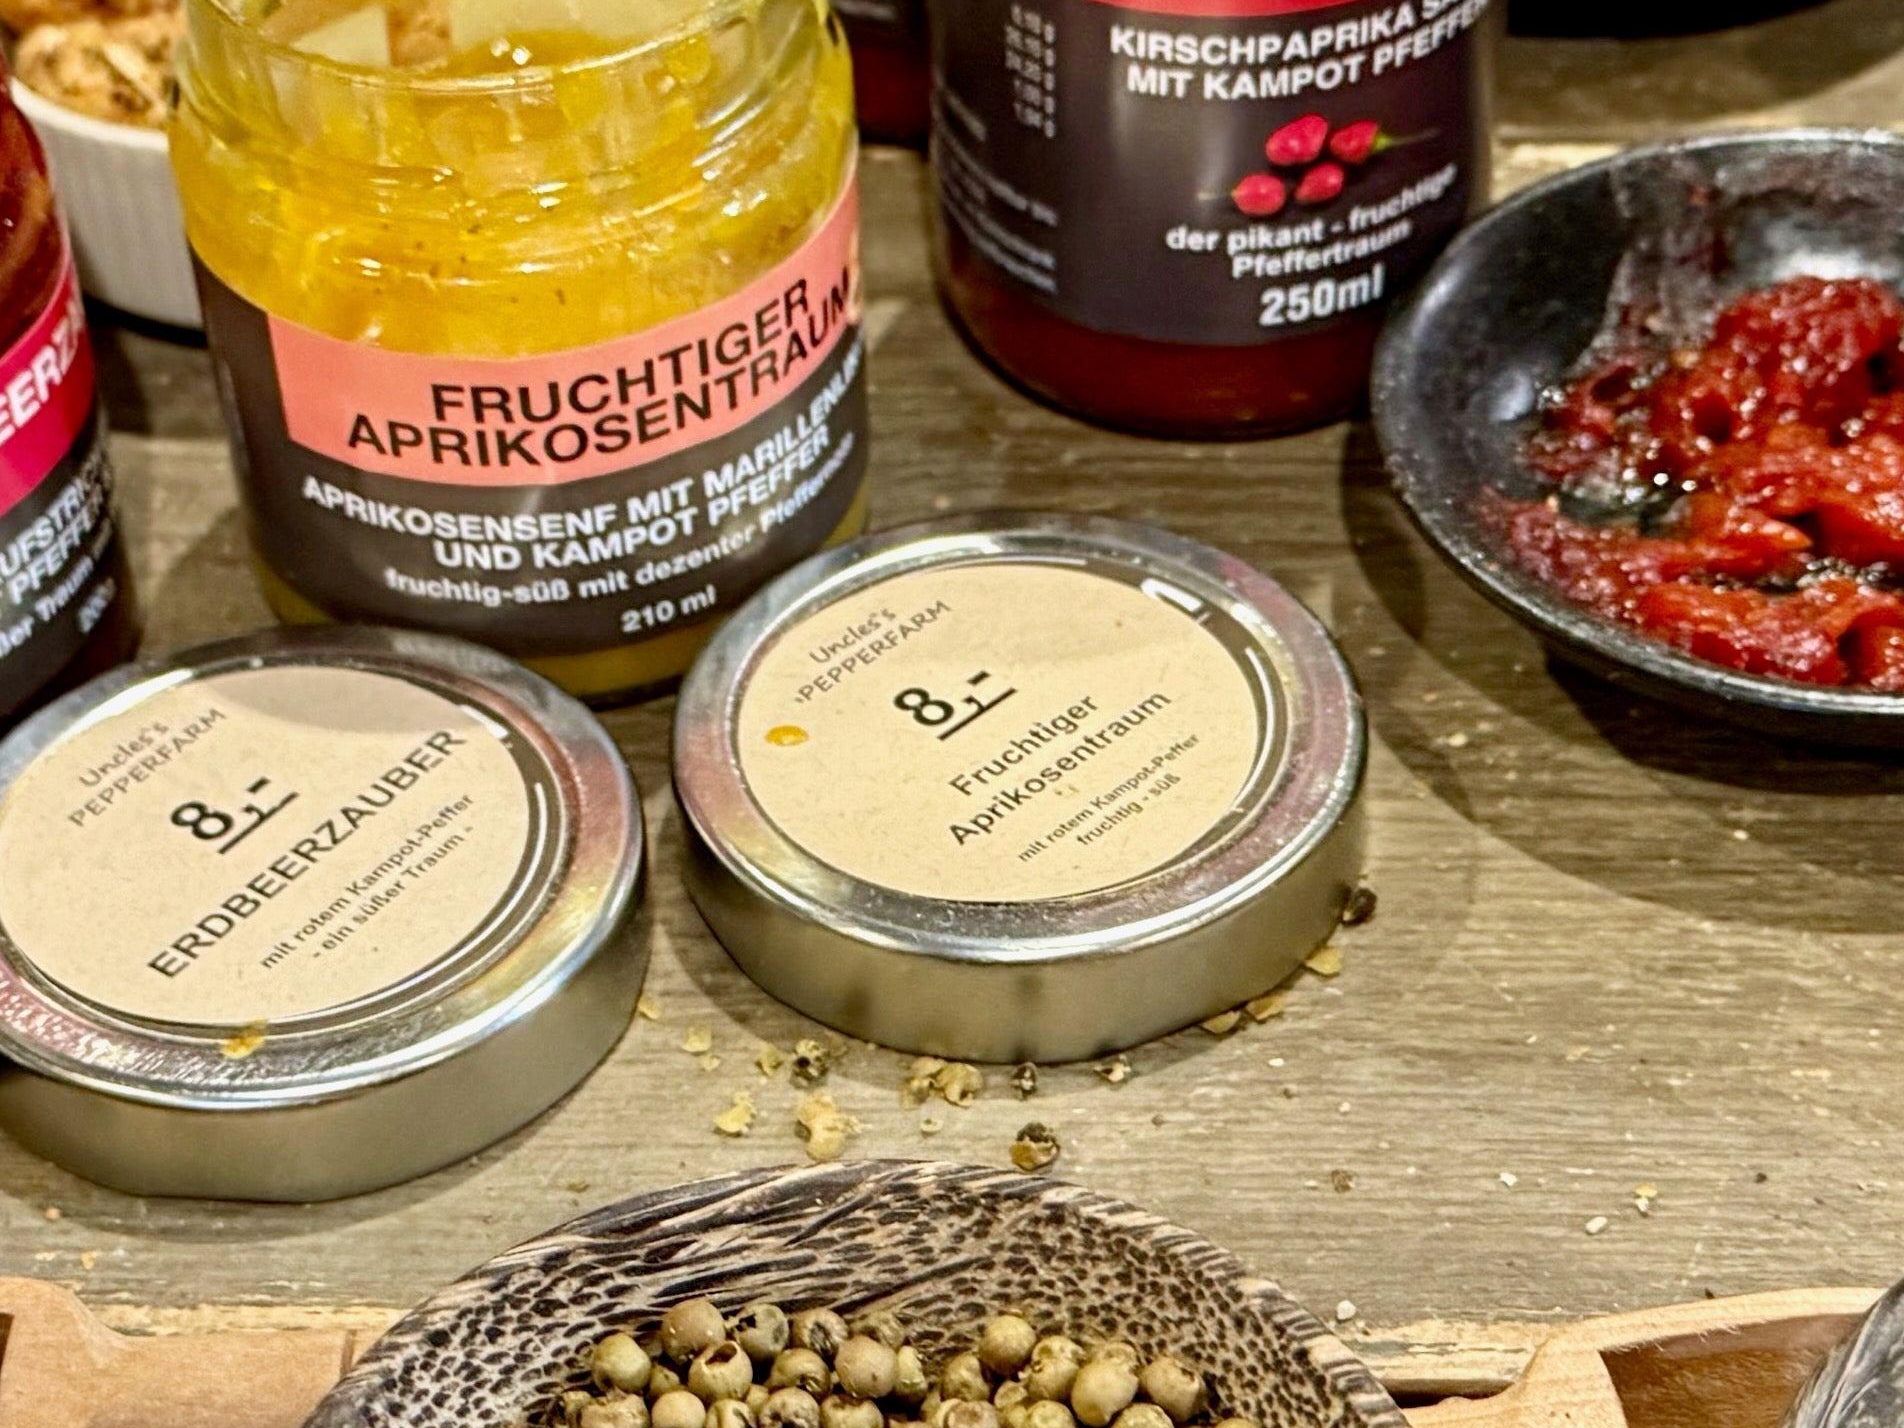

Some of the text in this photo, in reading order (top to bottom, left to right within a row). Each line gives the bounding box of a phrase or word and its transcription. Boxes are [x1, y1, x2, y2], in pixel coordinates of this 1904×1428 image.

[1108, 2, 1415, 69] KIRSCHPAPRIKA
[1126, 66, 1194, 100] MIT
[1202, 54, 1362, 103] KAMPOT
[1165, 163, 1459, 262] der pikant fruchtige
[1231, 220, 1412, 280] Pfeffertraum
[1258, 264, 1385, 327] 250ml
[430, 277, 808, 424] FRUCHTIGER
[302, 475, 616, 543] APRIKOSENSENF
[626, 477, 694, 524] MIT
[435, 538, 521, 572] UND
[531, 505, 699, 570] KAMPOT
[707, 424, 829, 526] PFEFFER
[385, 526, 755, 608] fruchtig-süß mit dezenter
[620, 584, 717, 634] 210 ml
[797, 600, 952, 703] PEPPERFARM
[68, 708, 227, 827] PEPPERFARM
[948, 689, 1172, 849] Aprikosentraum
[950, 691, 1102, 799] Fruchtiger
[1018, 840, 1049, 863] mit
[1046, 808, 1095, 844] rotem
[1076, 773, 1182, 846] fruchtig süß
[147, 728, 468, 980] ERDBEERZAUBER
[322, 924, 356, 951] ein
[402, 832, 466, 880] Traum
[259, 940, 298, 970] mit
[292, 895, 352, 943] rotem
